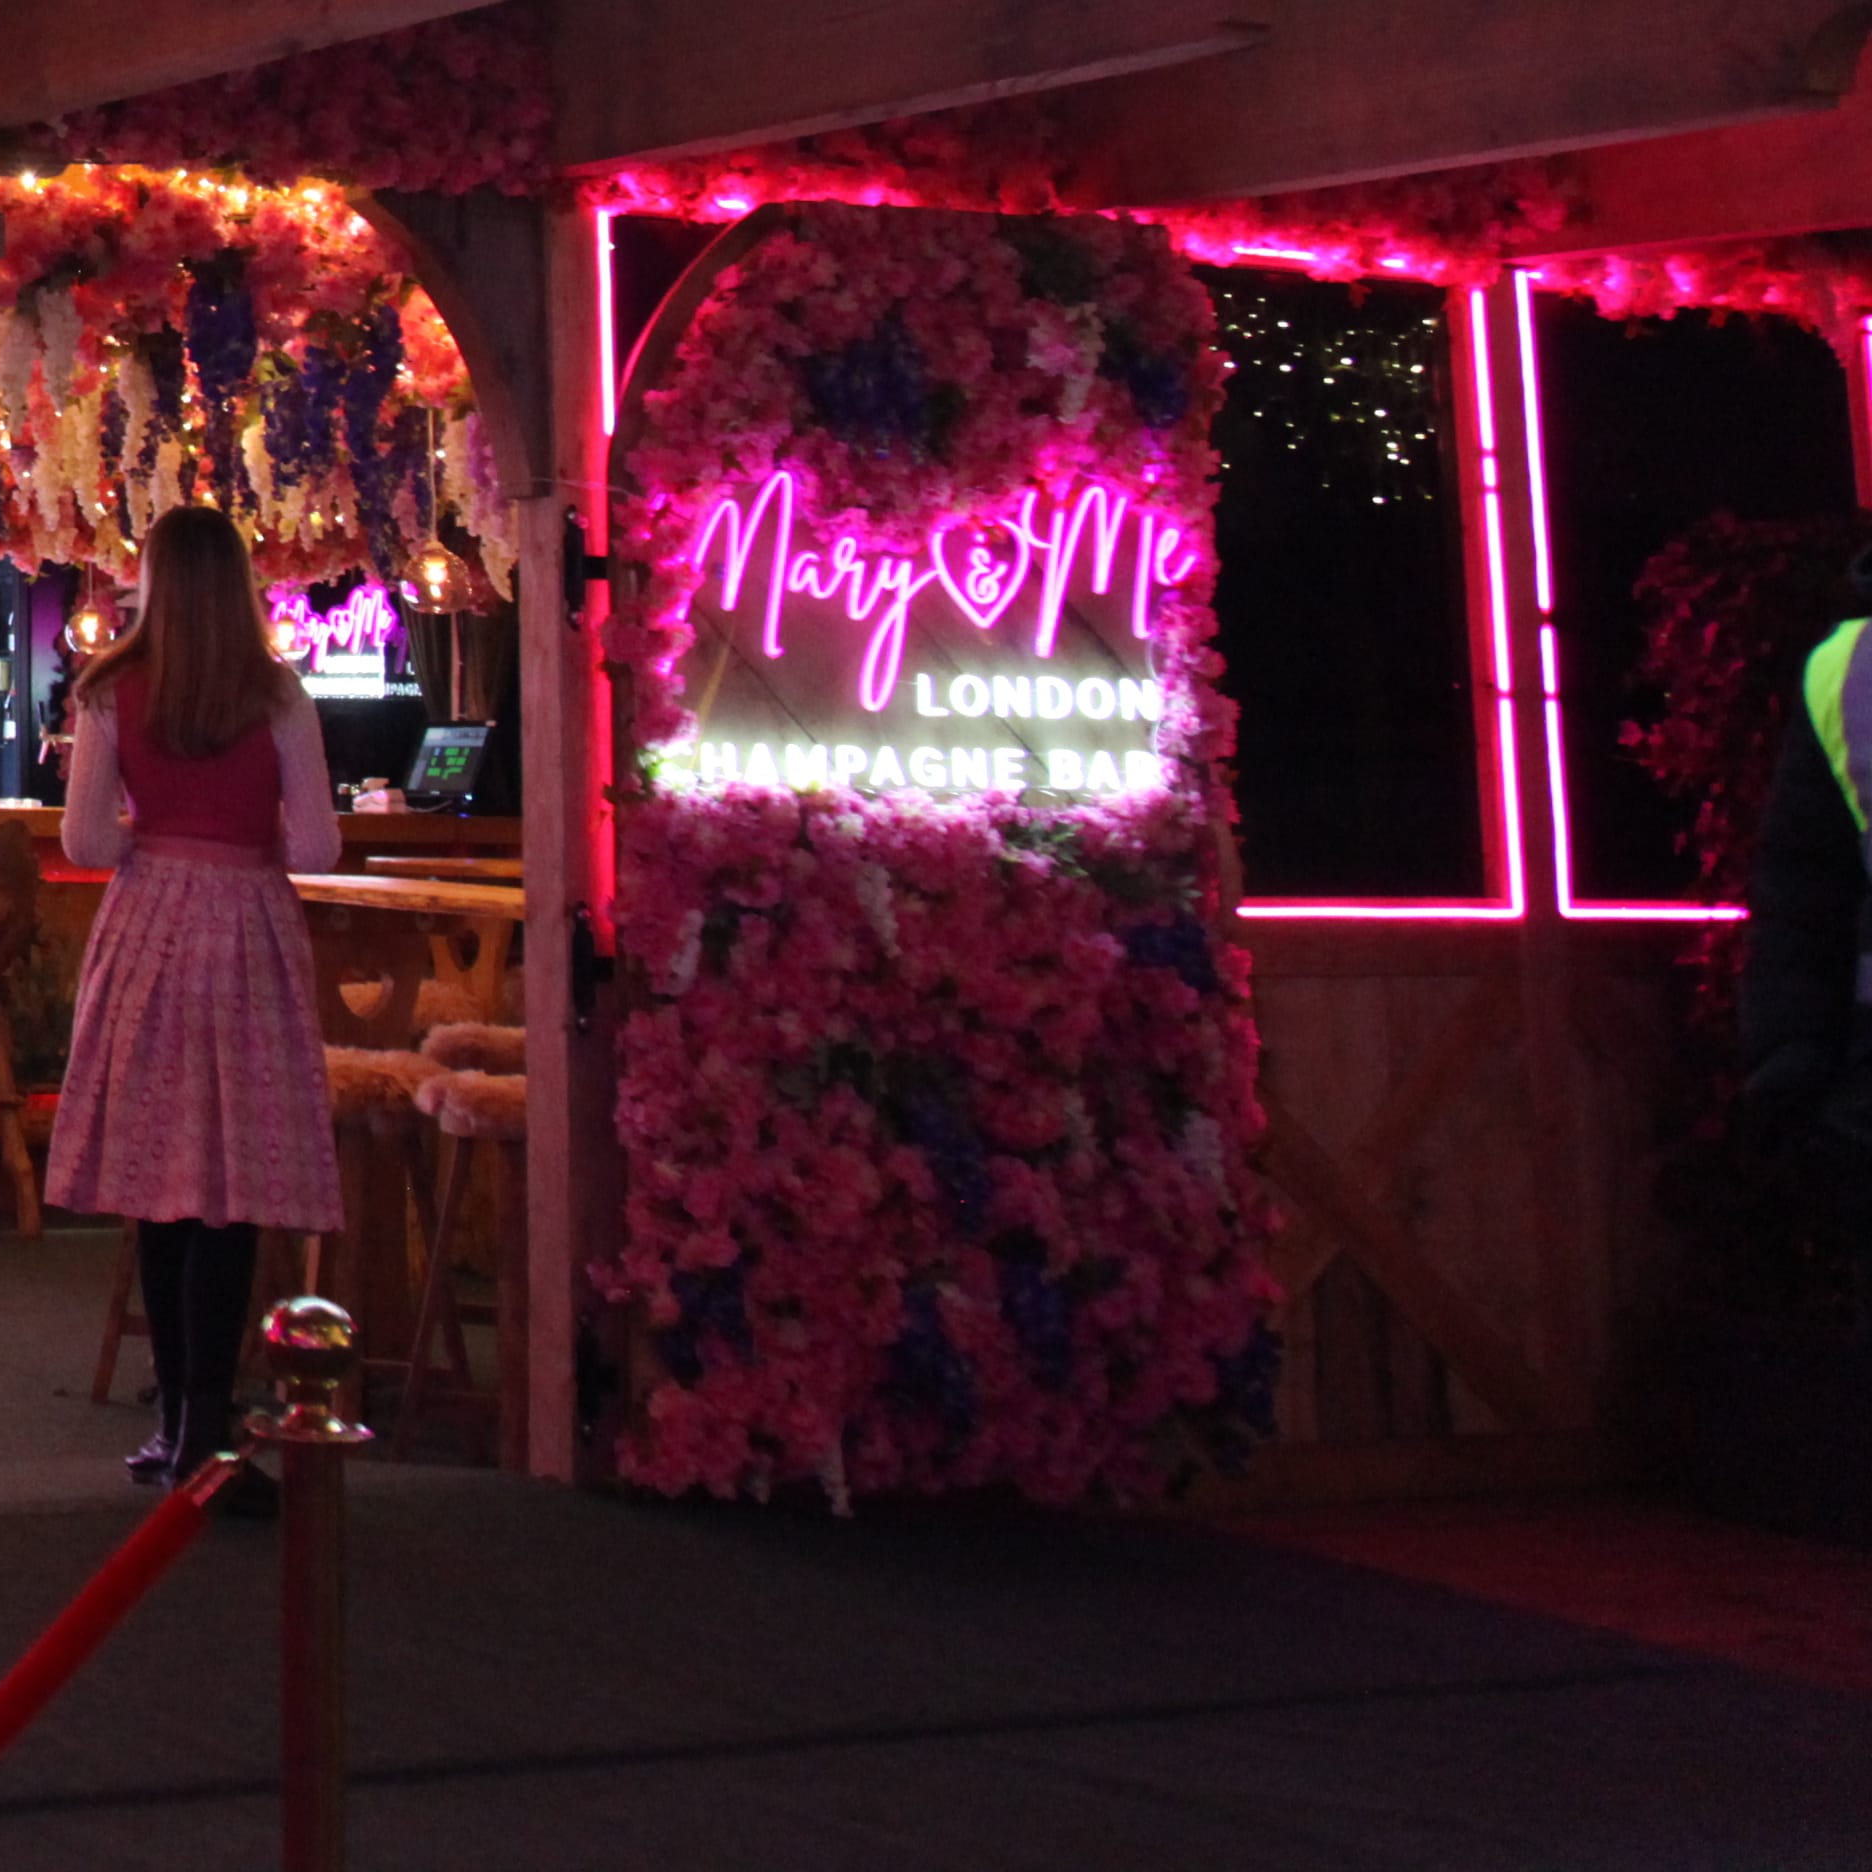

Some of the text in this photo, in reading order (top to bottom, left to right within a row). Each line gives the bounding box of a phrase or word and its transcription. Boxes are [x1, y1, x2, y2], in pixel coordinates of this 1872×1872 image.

[658, 470, 936, 712] Mary
[1020, 482, 1197, 658] Me
[915, 672, 1160, 722] LONDON
